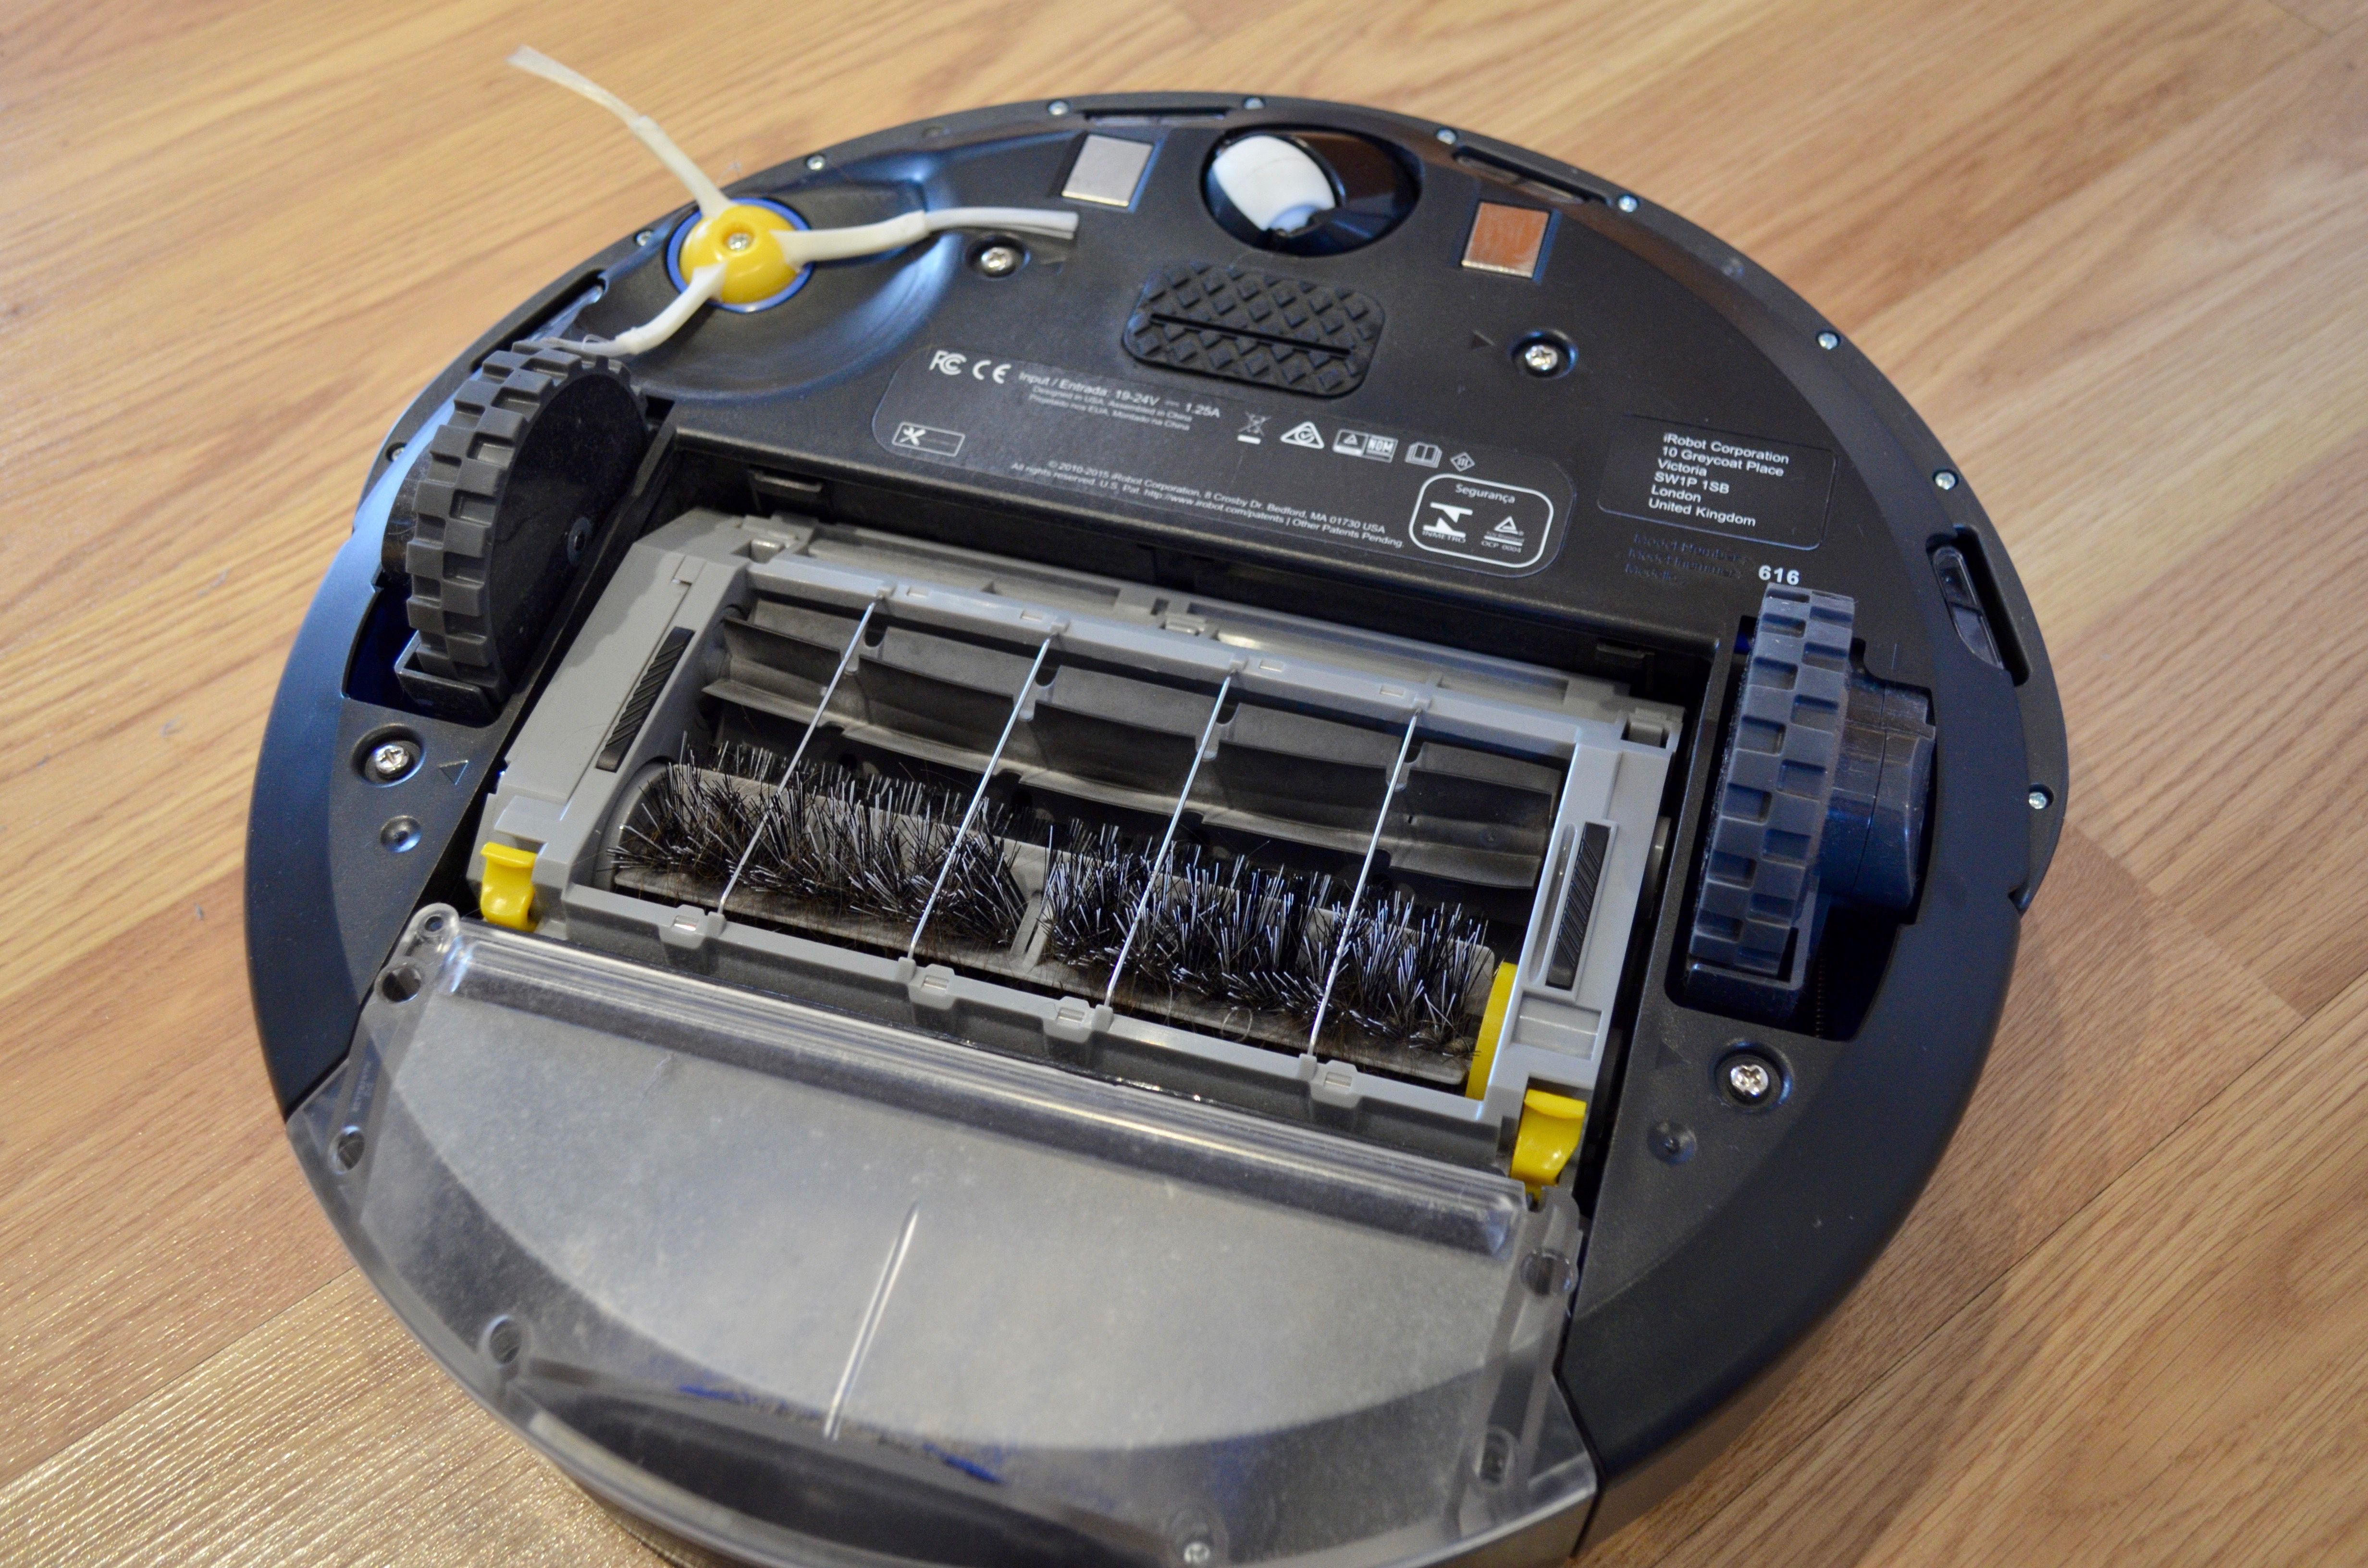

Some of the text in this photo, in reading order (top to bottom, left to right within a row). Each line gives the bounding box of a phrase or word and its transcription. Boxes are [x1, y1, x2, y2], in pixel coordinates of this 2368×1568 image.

[1019, 371, 1050, 385] Input
[1115, 389, 1161, 406] 19-24V
[1185, 402, 1221, 418] 1.25A
[1663, 432, 1789, 465] iRobot Corporation
[1657, 457, 1707, 477] Victoria
[1663, 445, 1785, 477] 10 Greycoat Place
[1455, 483, 1516, 504] Segurança
[1651, 484, 1702, 503] London
[1654, 470, 1730, 494] SW1P 1SB
[1058, 462, 1110, 478] 2010-2015
[1110, 472, 1143, 485] iRobot
[1213, 492, 1249, 508] Crosby
[1310, 511, 1328, 523] MA
[1329, 515, 1361, 529] 01730
[1362, 522, 1385, 534] USA
[1648, 497, 1756, 527] United Kingdom
[1292, 518, 1320, 531] Other
[1321, 524, 1360, 539] Patents
[1758, 564, 1800, 586] 616
